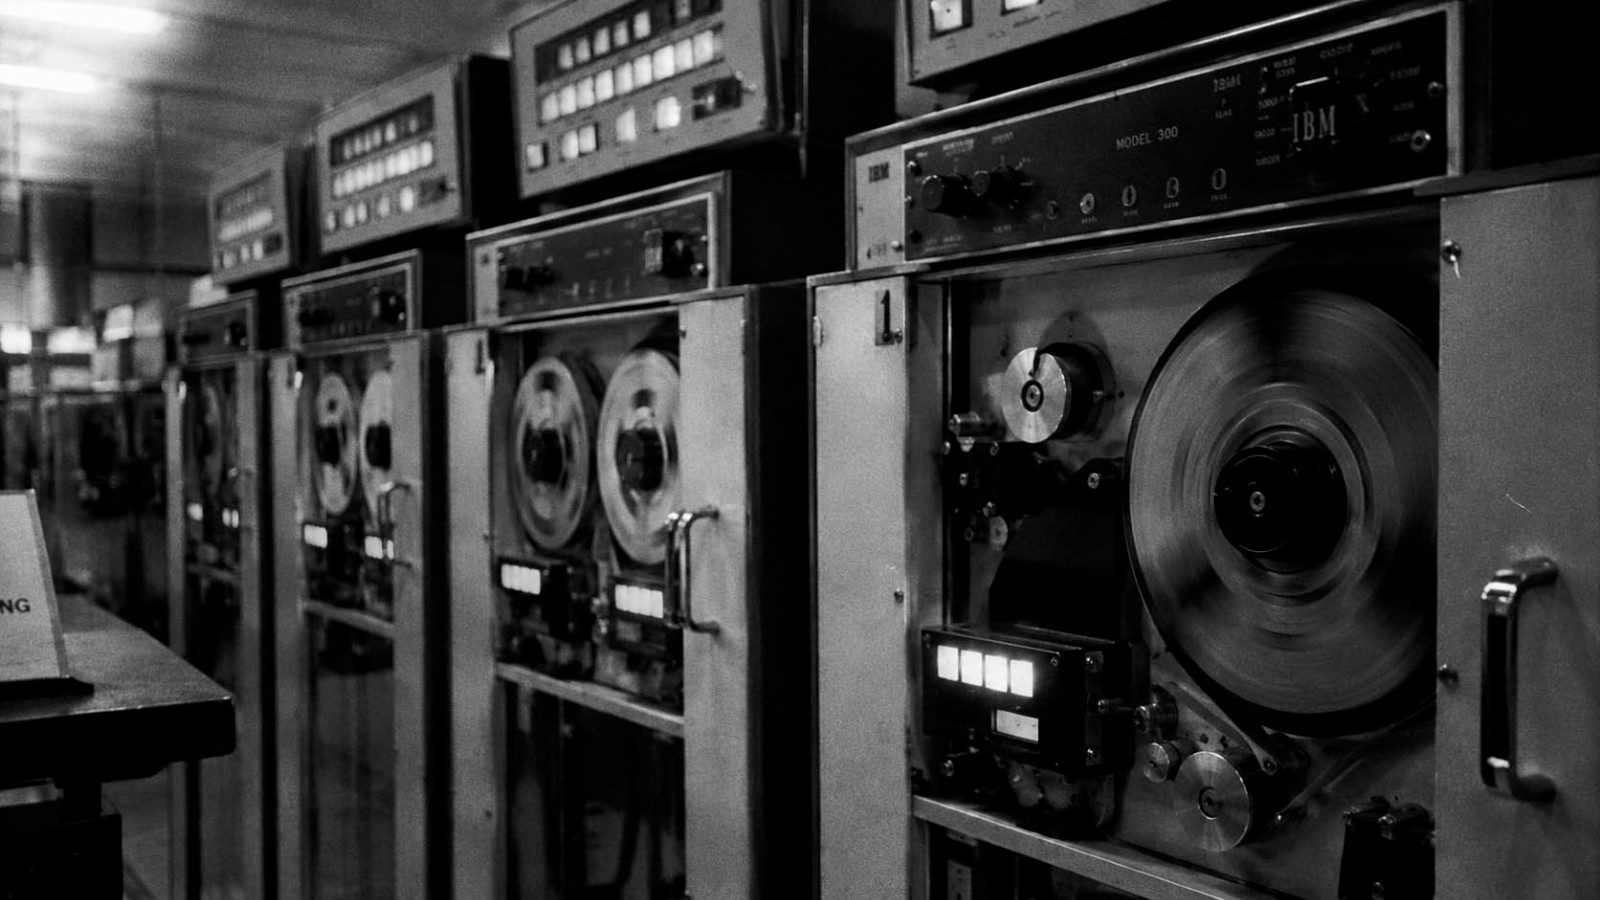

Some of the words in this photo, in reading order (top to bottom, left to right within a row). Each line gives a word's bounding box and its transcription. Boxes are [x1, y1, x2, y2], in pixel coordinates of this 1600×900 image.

[1293, 104, 1336, 143] IBM
[1116, 132, 1152, 150] MODEL
[1157, 125, 1179, 142] 300
[0, 597, 31, 615] NG
